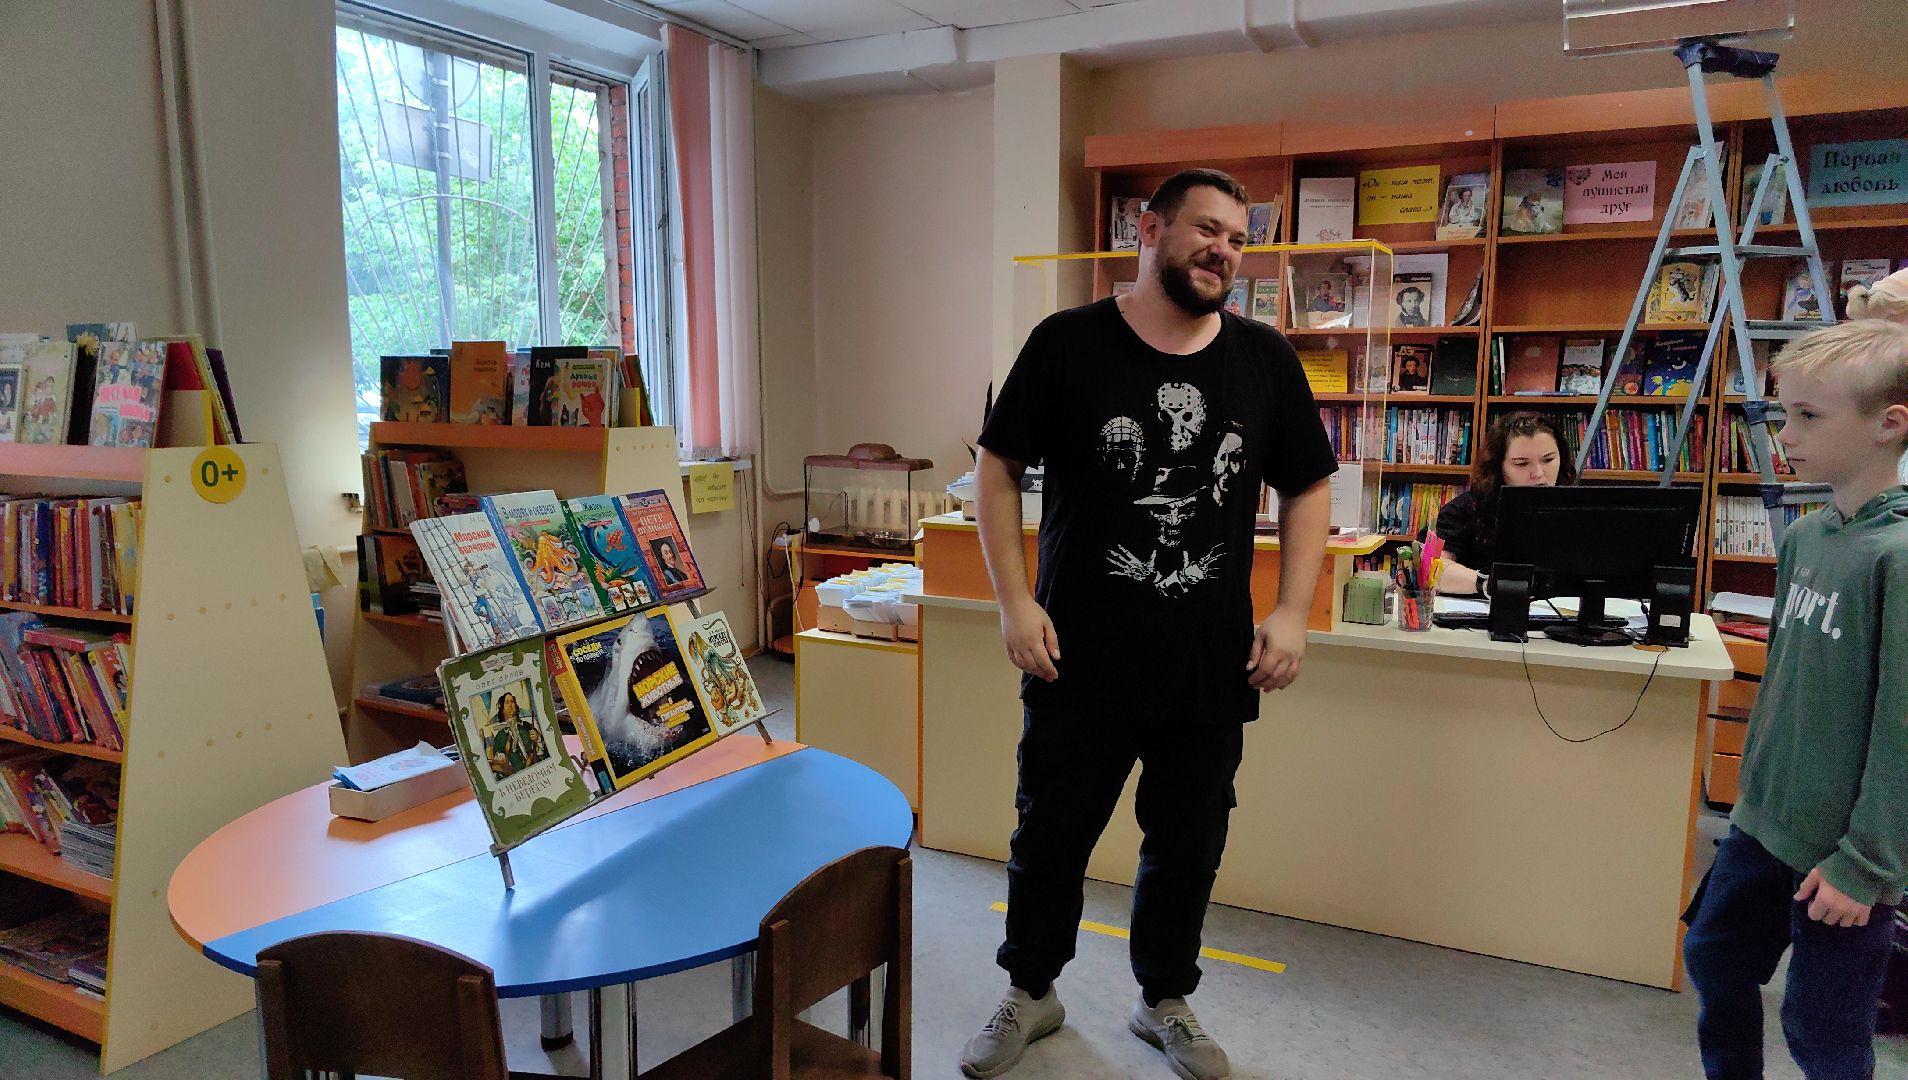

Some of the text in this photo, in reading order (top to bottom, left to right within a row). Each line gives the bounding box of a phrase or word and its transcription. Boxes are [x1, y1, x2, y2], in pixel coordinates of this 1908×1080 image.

[1824, 152, 1901, 170] Первая
[1582, 184, 1649, 199] пушистый
[1821, 176, 1899, 194] любовь
[1600, 202, 1631, 215] друг
[201, 460, 239, 488] 0+
[453, 529, 492, 542] Морской
[458, 541, 498, 555] волчонок
[633, 661, 680, 698] МОРСКИЕ
[640, 674, 684, 709] ЖИВОТНЫЕ
[505, 763, 558, 793] НЕВЕДОМЫМ
[514, 778, 552, 802] БЕРЕГАМ
